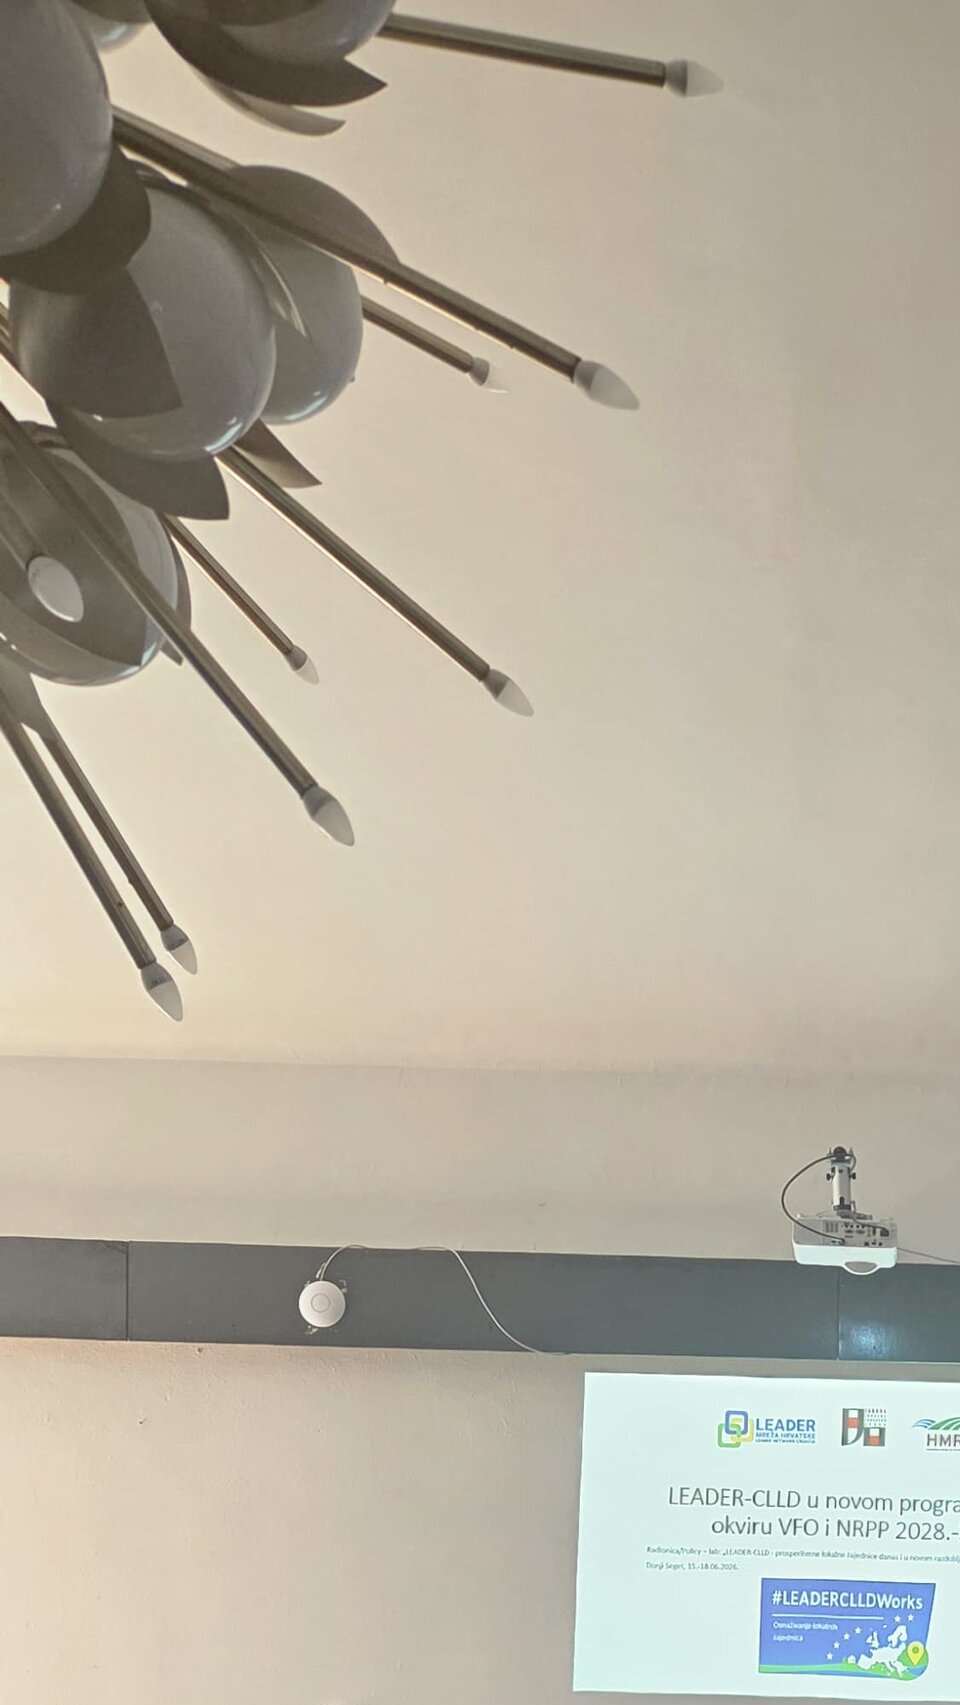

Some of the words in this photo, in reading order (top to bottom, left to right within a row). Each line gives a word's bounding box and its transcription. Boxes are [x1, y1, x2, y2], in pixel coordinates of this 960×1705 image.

[756, 1418, 816, 1432] LEADER
[669, 1486, 801, 1508] LEADER-CLLD
[807, 1495, 819, 1509] u
[826, 1495, 893, 1511] novom
[711, 1515, 773, 1535] okviru
[778, 1518, 820, 1536] VFO
[825, 1518, 830, 1536] i
[836, 1519, 890, 1538] NRPP
[771, 1589, 924, 1610] #LEADERCLLDWorks
